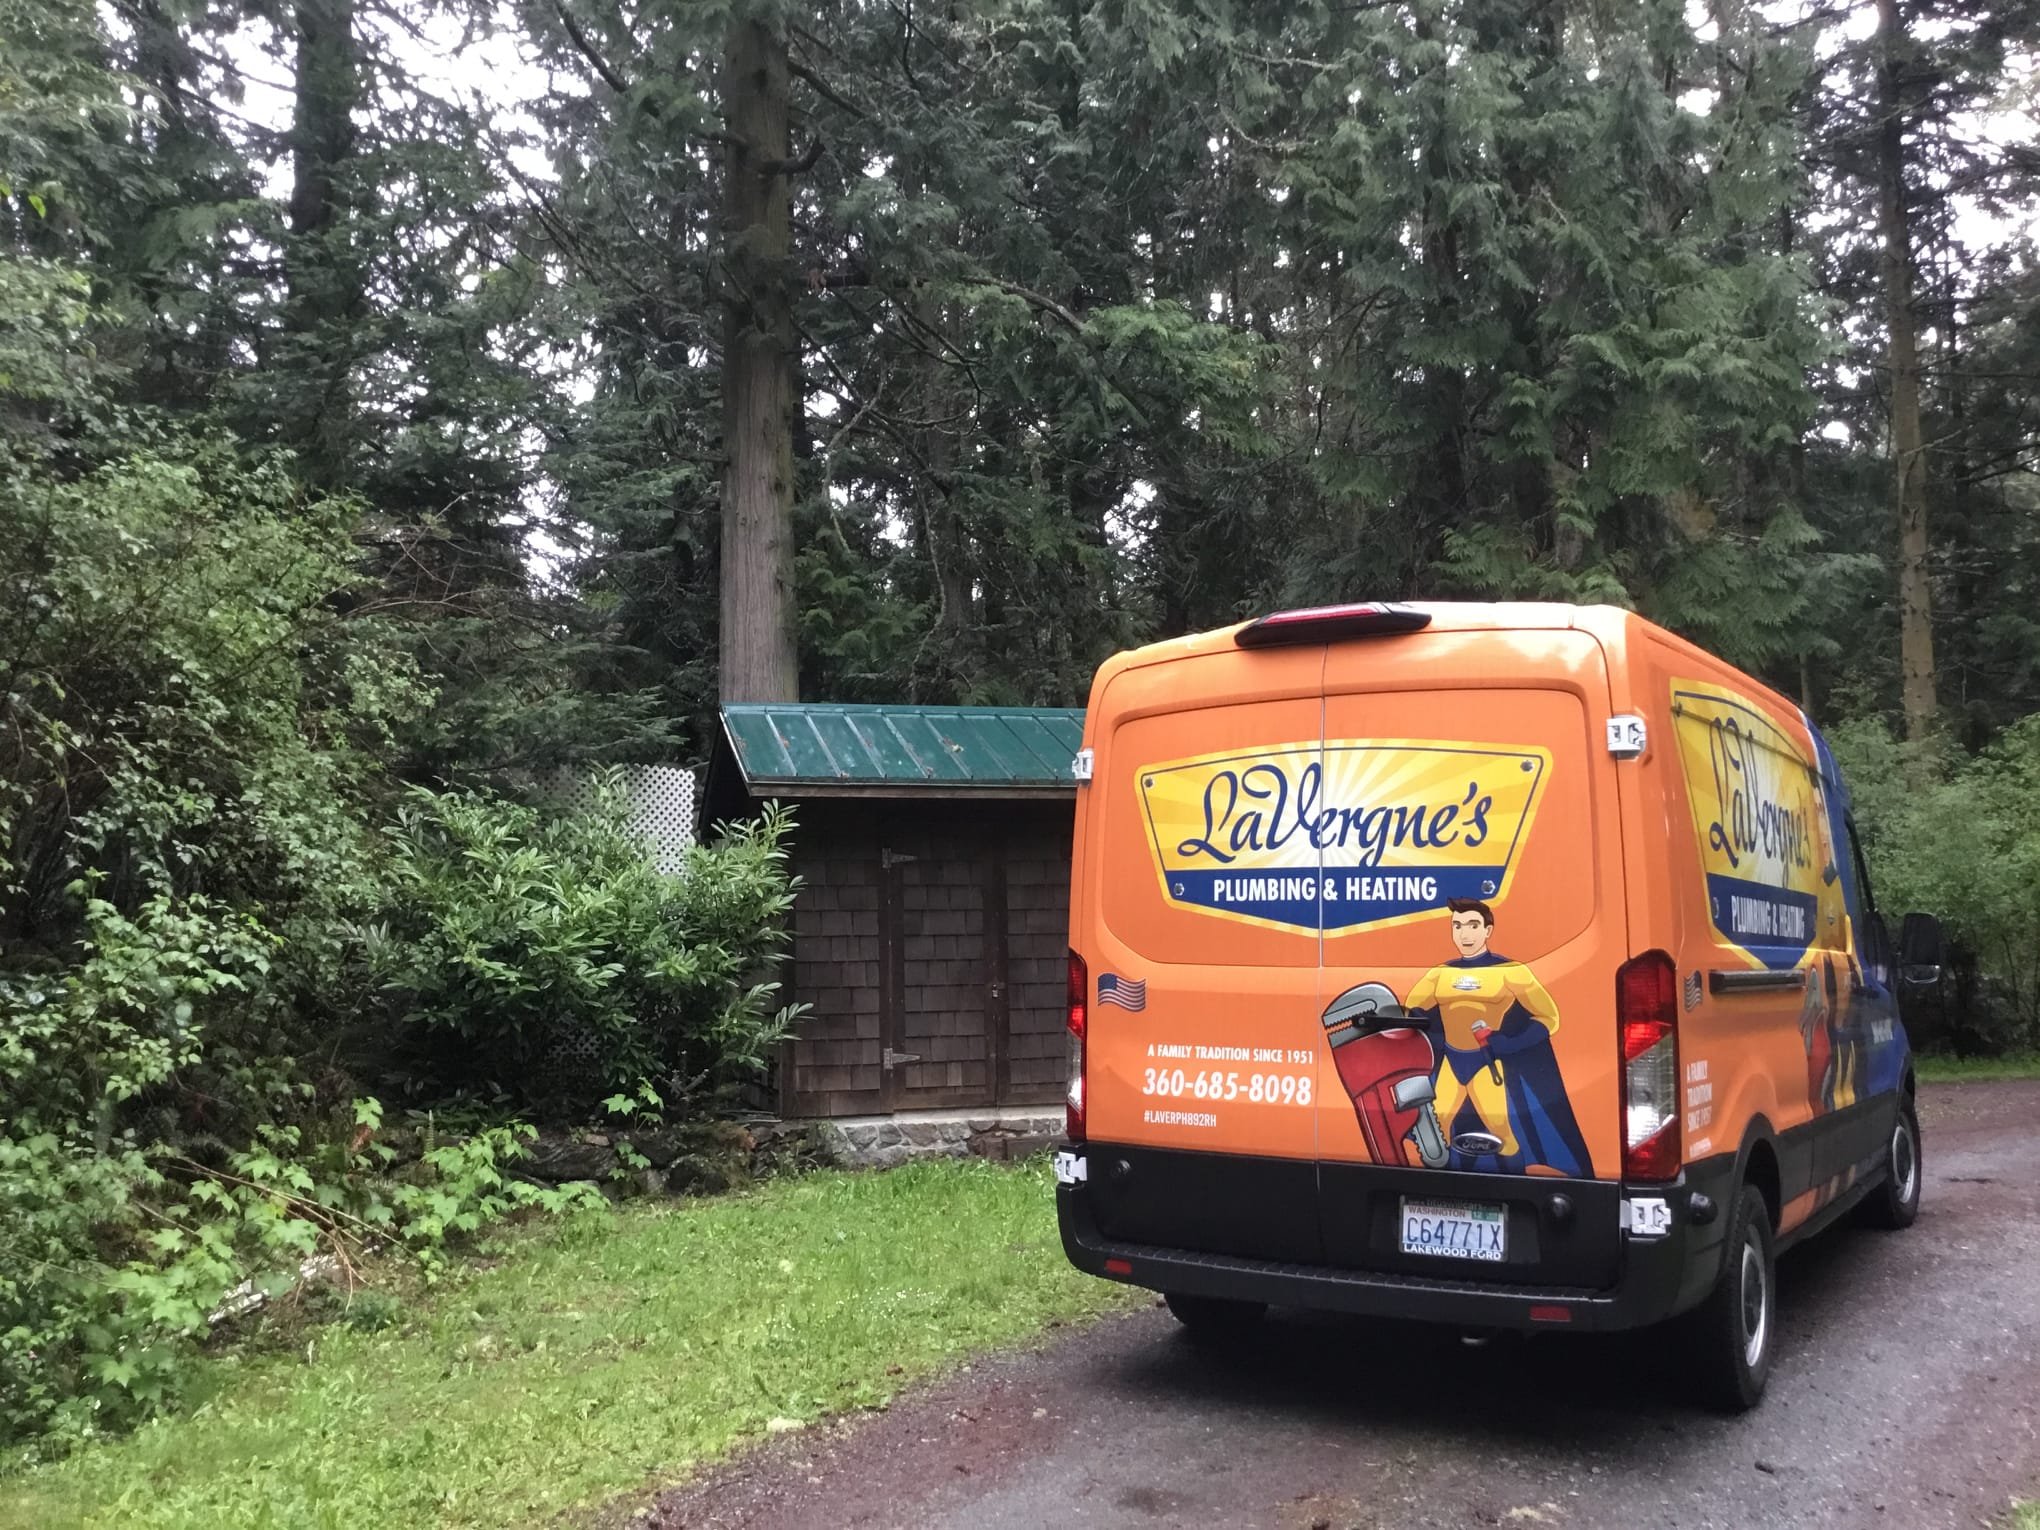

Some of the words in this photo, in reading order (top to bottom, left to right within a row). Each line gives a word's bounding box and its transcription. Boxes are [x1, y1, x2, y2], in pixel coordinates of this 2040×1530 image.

[1177, 762, 1493, 869] LaVergne's
[1213, 877, 1316, 902] PLUMBING
[1322, 878, 1338, 901] &
[1346, 877, 1437, 901] HEATING
[1731, 895, 1771, 935] PLUMBING
[1147, 1044, 1155, 1057] A
[1157, 1044, 1192, 1059] FAMILY
[1195, 1046, 1250, 1061] TRADITION
[1253, 1048, 1283, 1063] SINCE
[1287, 1050, 1313, 1064] 1951
[1142, 1067, 1312, 1105] 360-685-8098
[1144, 1110, 1217, 1127] #LAVERPH892RH
[1462, 1138, 1490, 1151] Ford
[1407, 1206, 1466, 1218] WASHINGTON
[1407, 1216, 1501, 1252] C64771X
[1404, 1243, 1467, 1257] LAKEWOOD
[1470, 1249, 1502, 1261] FORD
